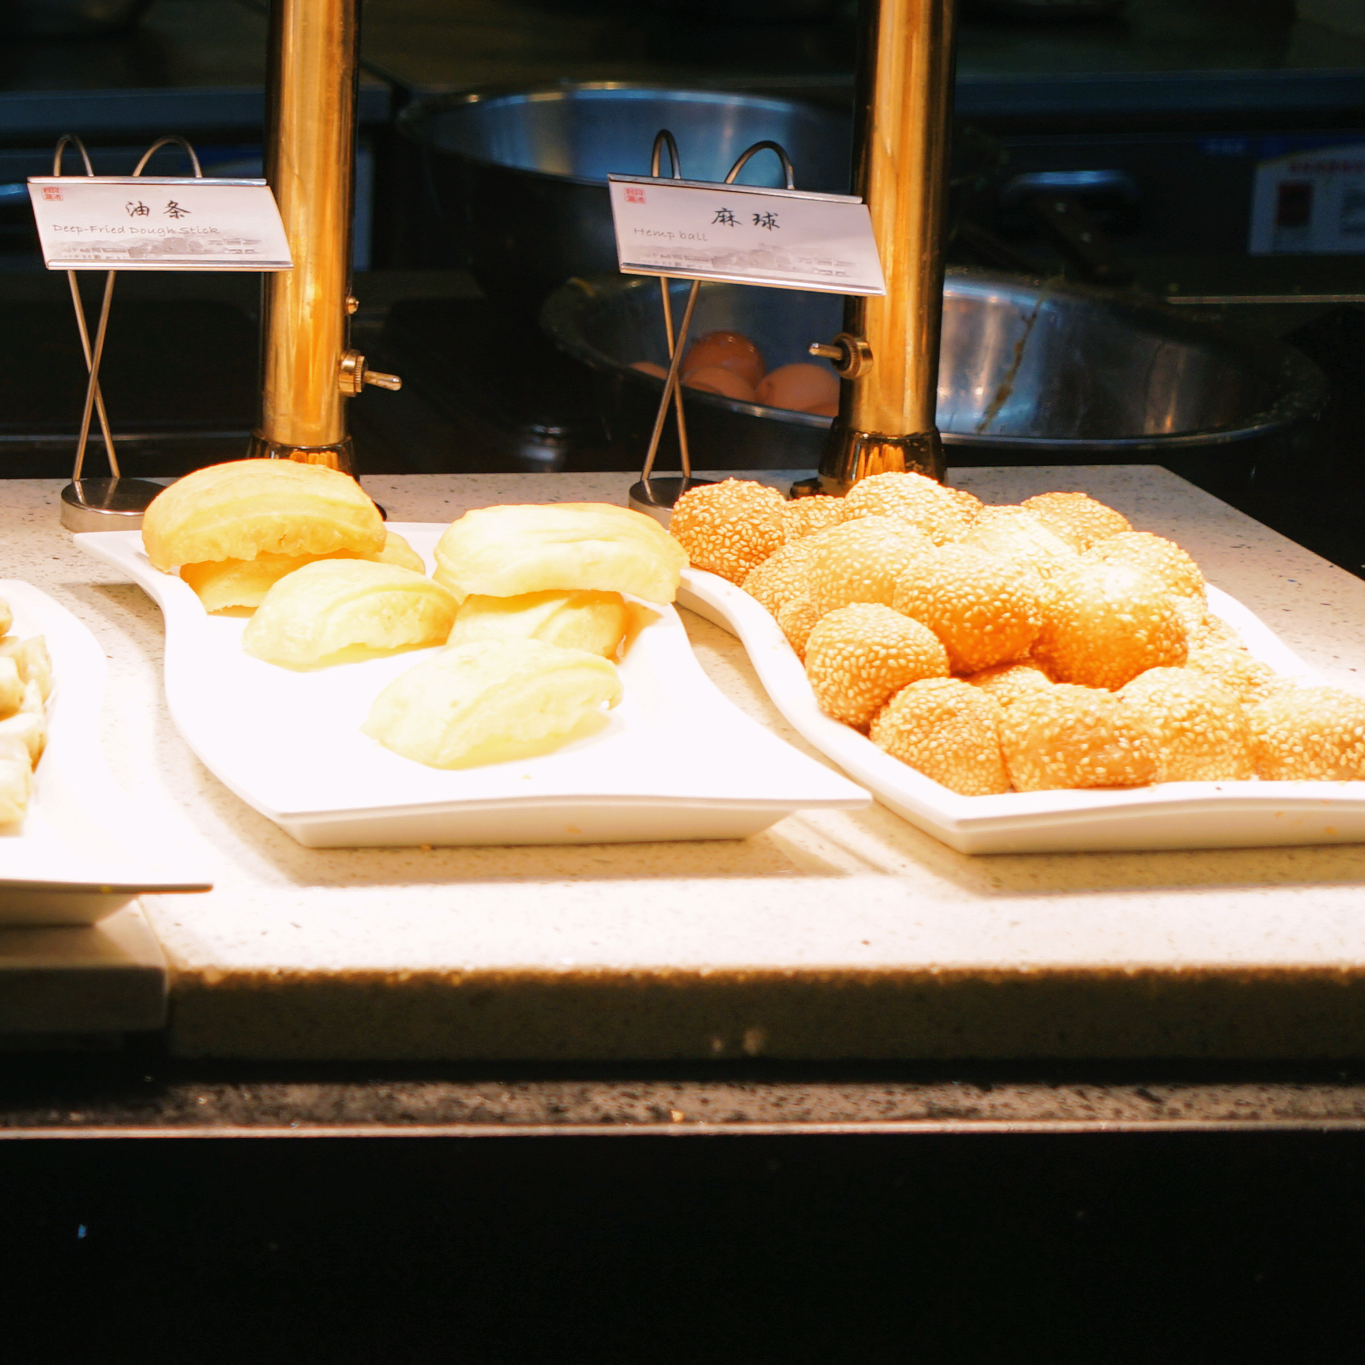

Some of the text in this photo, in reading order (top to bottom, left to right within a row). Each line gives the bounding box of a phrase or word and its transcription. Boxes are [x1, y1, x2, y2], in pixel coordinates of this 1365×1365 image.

[125, 200, 191, 220] 油条
[711, 207, 781, 231] 麻球
[52, 224, 220, 237] Deep-Fried Dough Stick
[634, 227, 708, 241] Hemp ball
